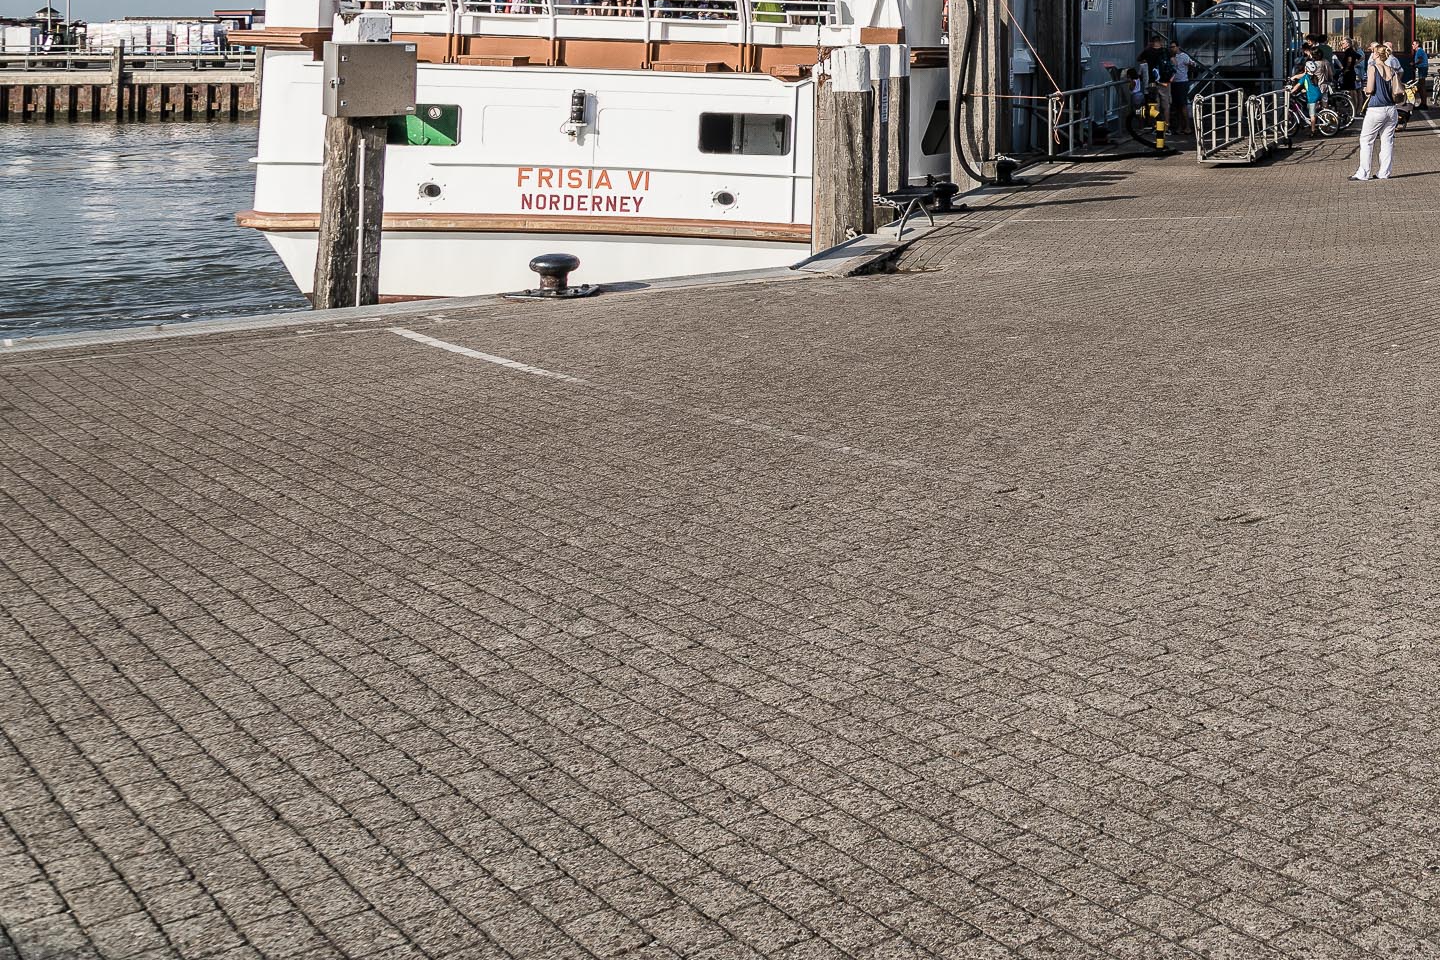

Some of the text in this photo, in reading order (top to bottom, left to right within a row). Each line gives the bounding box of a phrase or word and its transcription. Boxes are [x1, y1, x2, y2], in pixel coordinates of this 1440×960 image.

[517, 167, 650, 191] FRISIA VI
[520, 193, 644, 213] NORDERNEY
